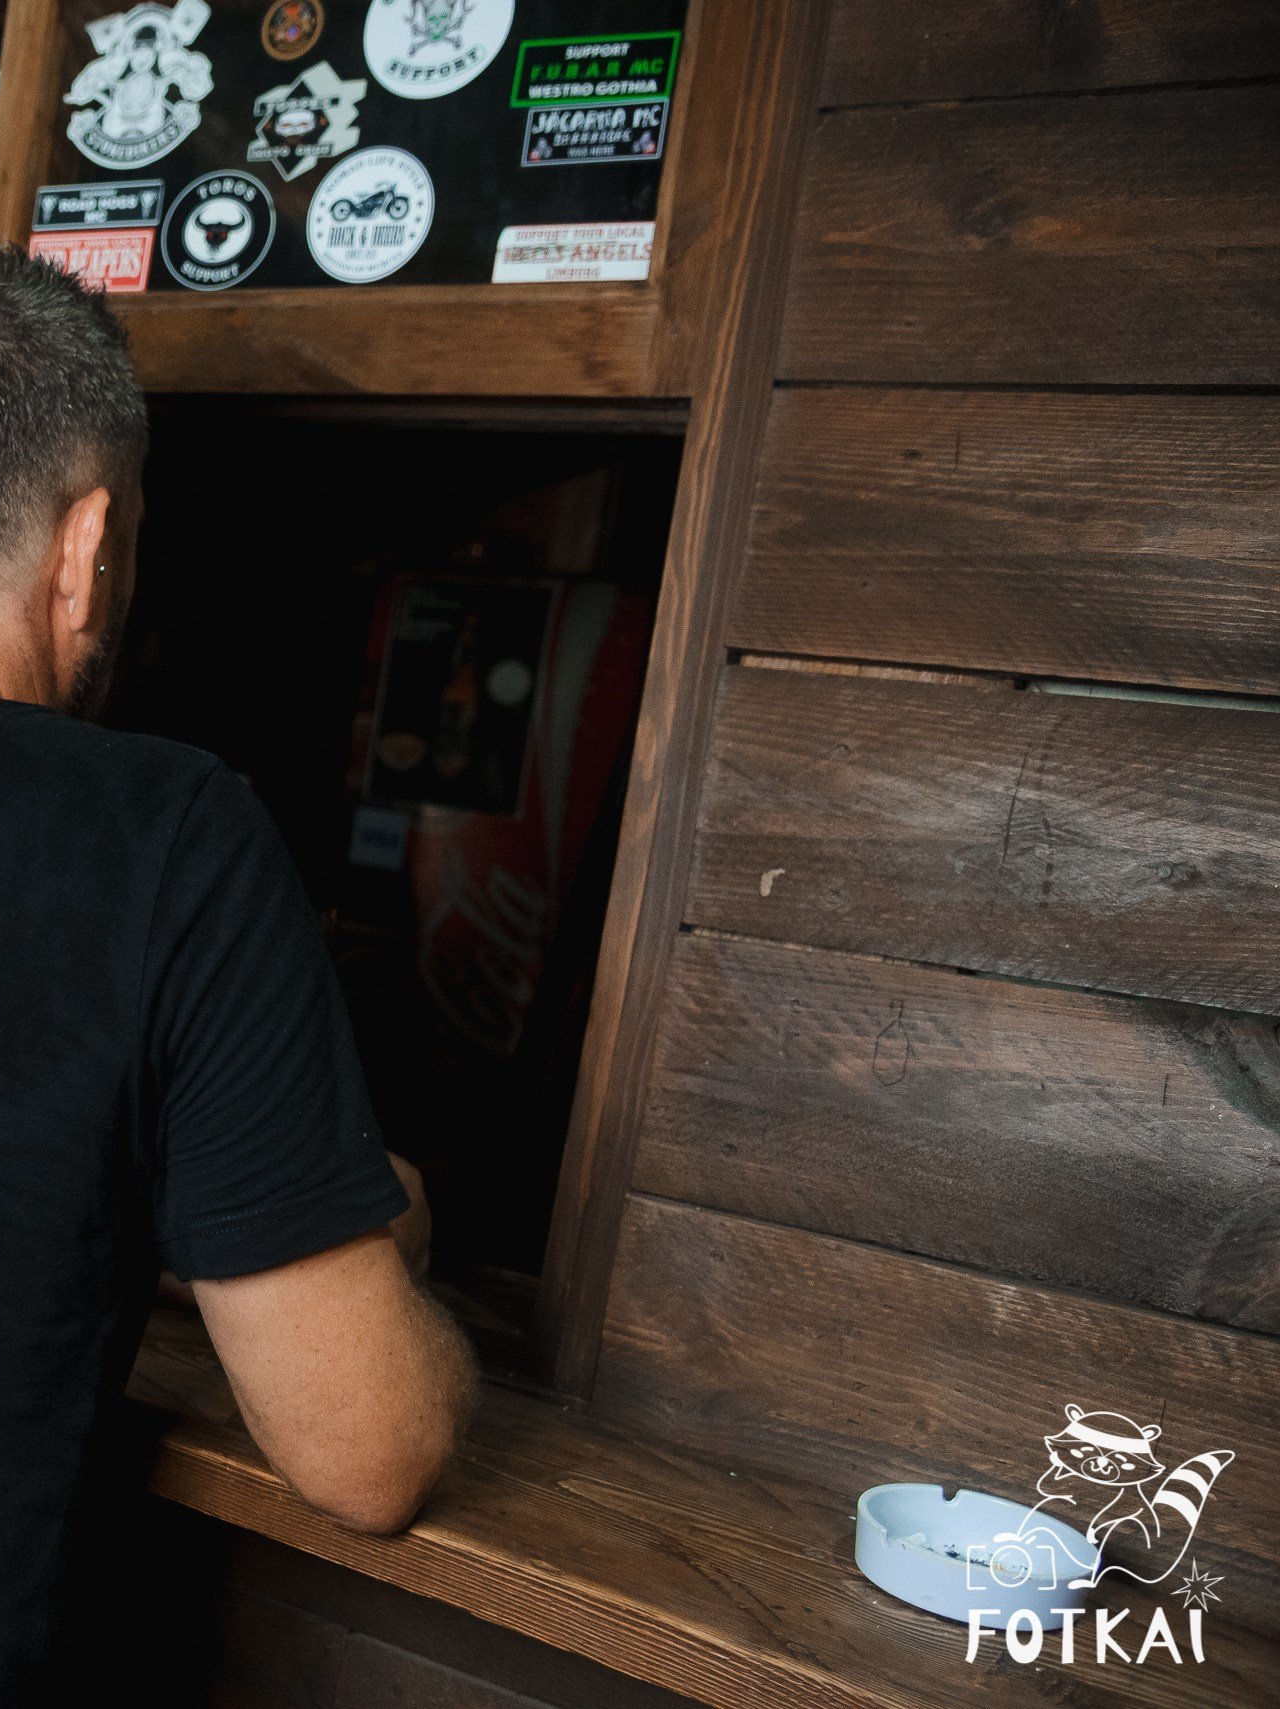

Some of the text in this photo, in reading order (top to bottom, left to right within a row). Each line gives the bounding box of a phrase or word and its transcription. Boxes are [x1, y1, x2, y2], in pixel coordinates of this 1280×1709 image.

[565, 43, 630, 60] SUPPORT
[387, 47, 477, 80] SUPPORT
[628, 58, 665, 77] MC
[528, 79, 658, 99] WESTRO GOTHIA
[632, 105, 661, 128] MC
[197, 178, 257, 202] TOROS
[181, 260, 240, 282] SUPPORT
